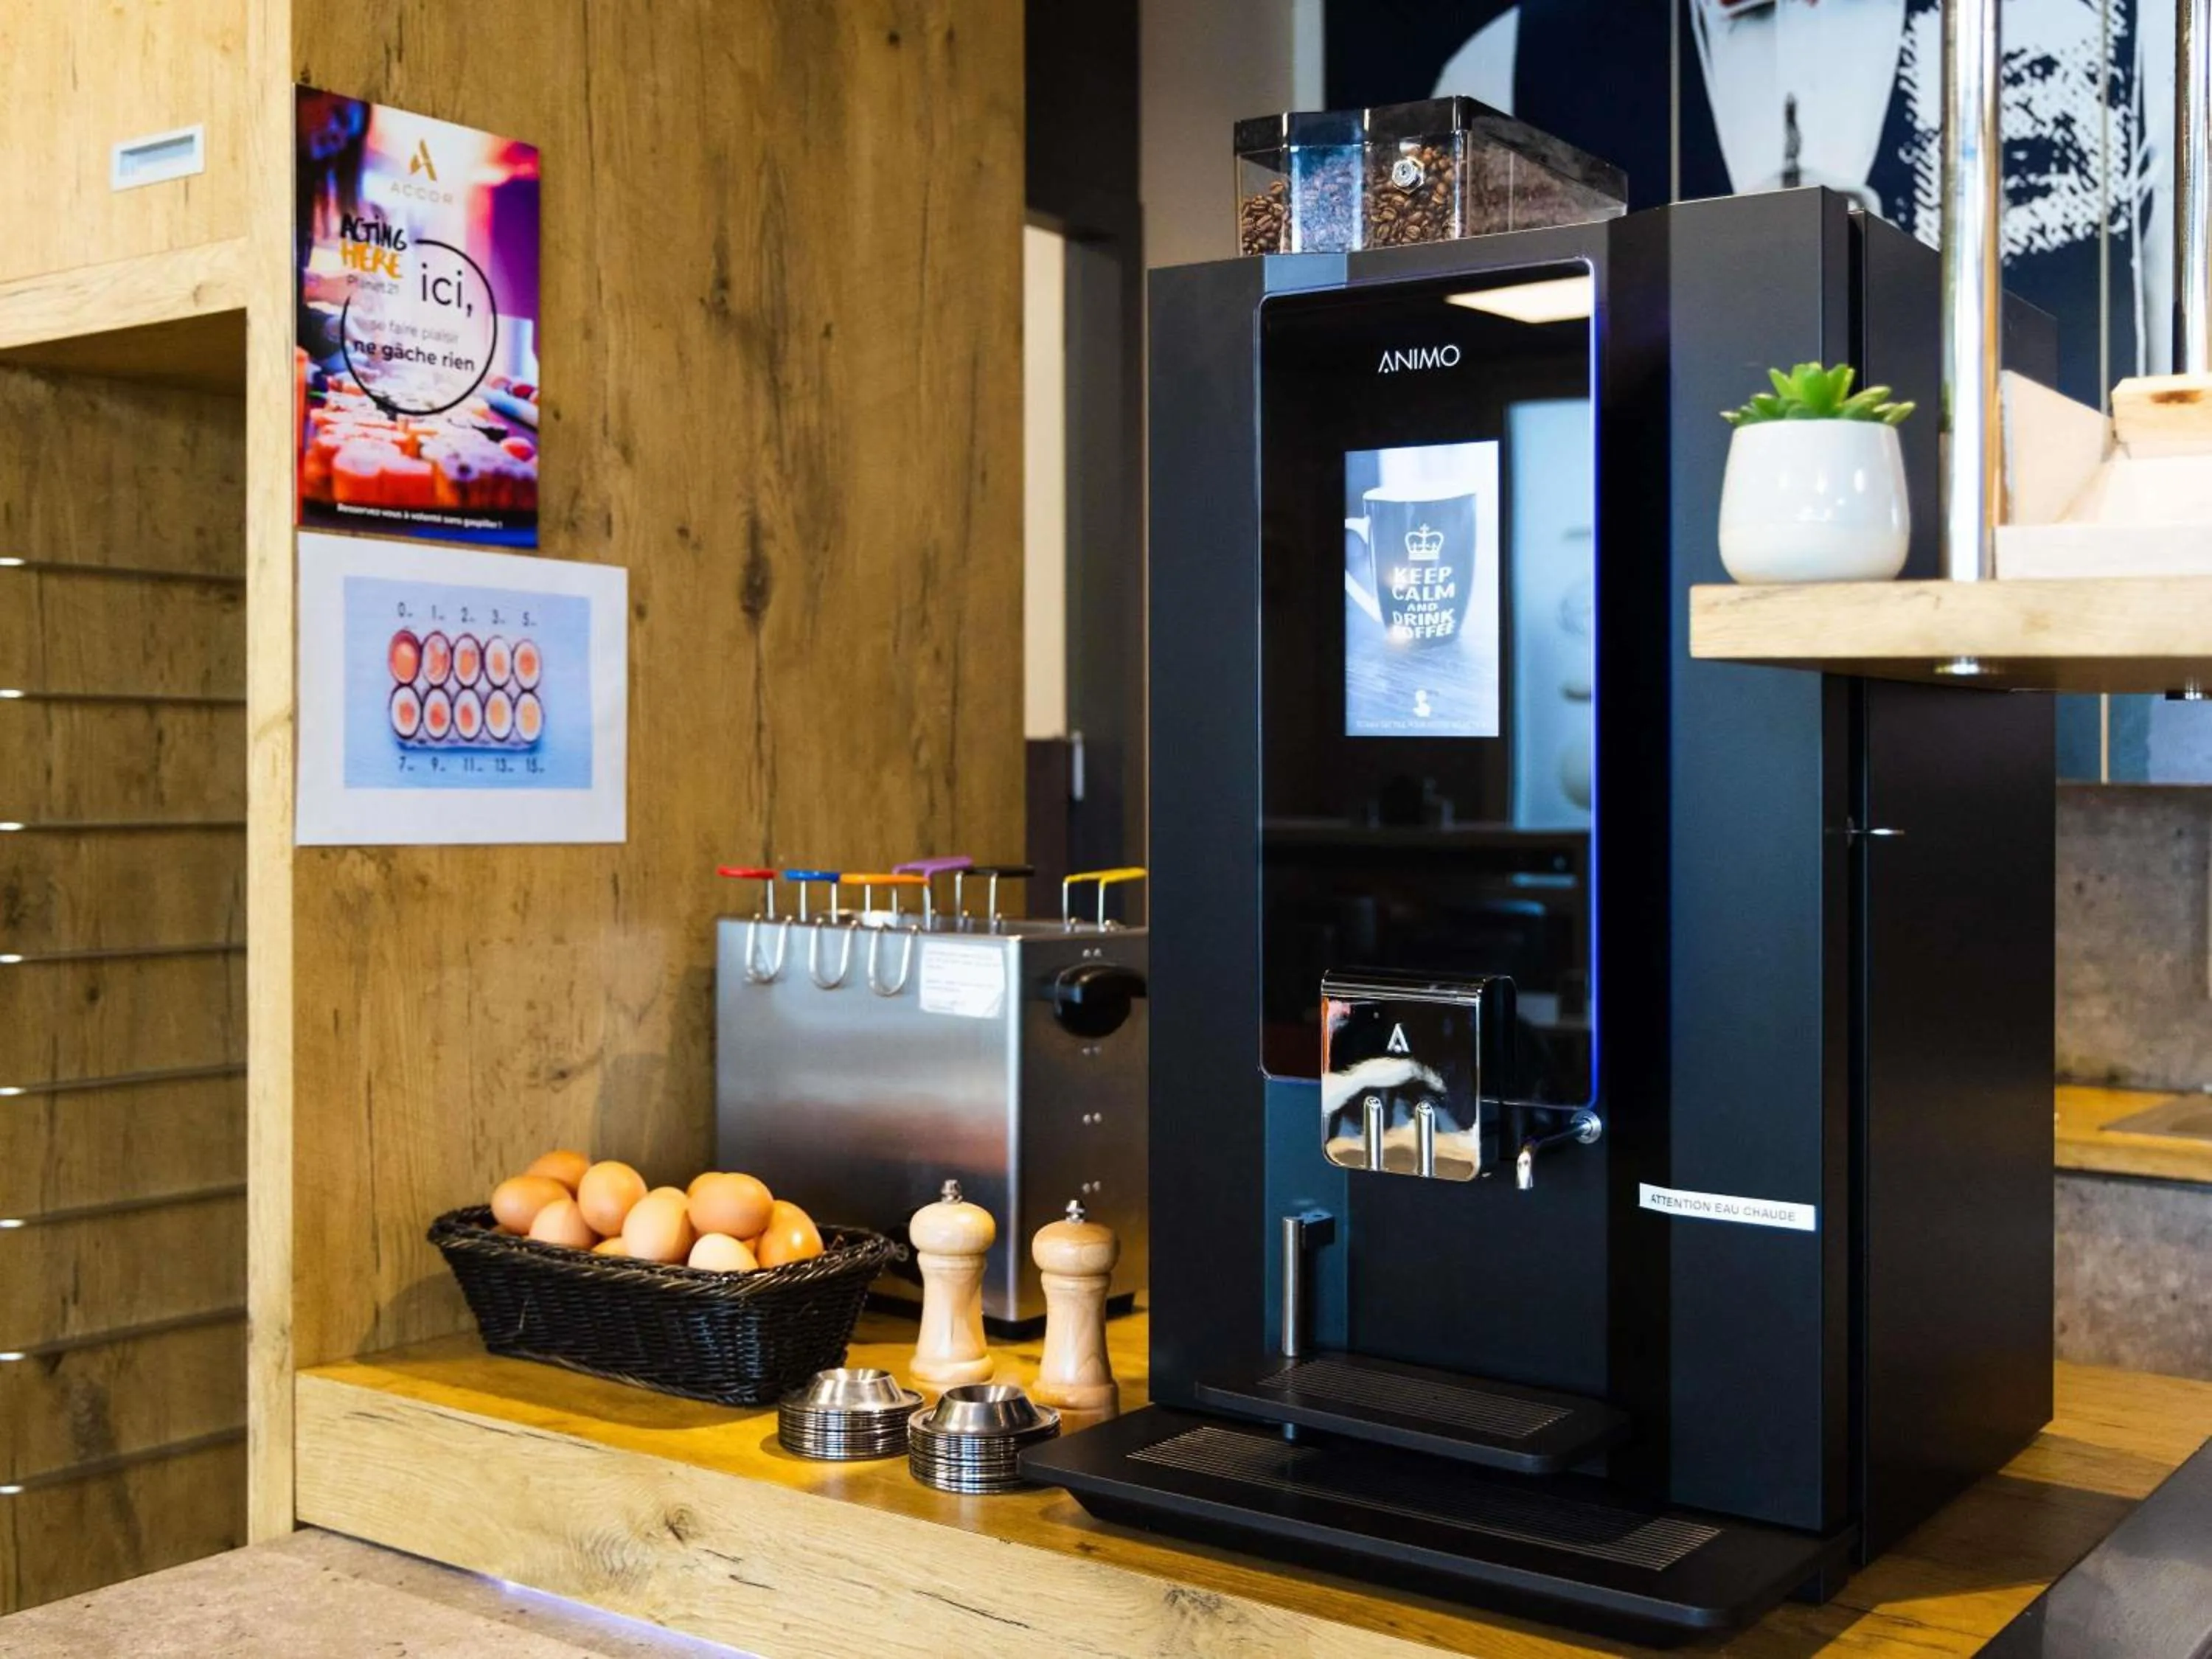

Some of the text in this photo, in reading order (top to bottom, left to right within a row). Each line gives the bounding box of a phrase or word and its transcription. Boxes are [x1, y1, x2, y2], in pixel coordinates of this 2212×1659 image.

[390, 181, 453, 204] ACCOR
[341, 212, 407, 251] ACTING
[341, 237, 403, 279] HERE
[422, 262, 473, 317] ici,
[354, 340, 475, 372] ne gâche rien
[1377, 344, 1461, 374] ANIMO
[1394, 566, 1453, 584] KEEP
[1392, 582, 1455, 601] CALM
[1392, 608, 1455, 626] DRINK
[1407, 602, 1439, 613] AND
[1651, 1194, 1796, 1222] ATTENTION EAU CHAUDE
